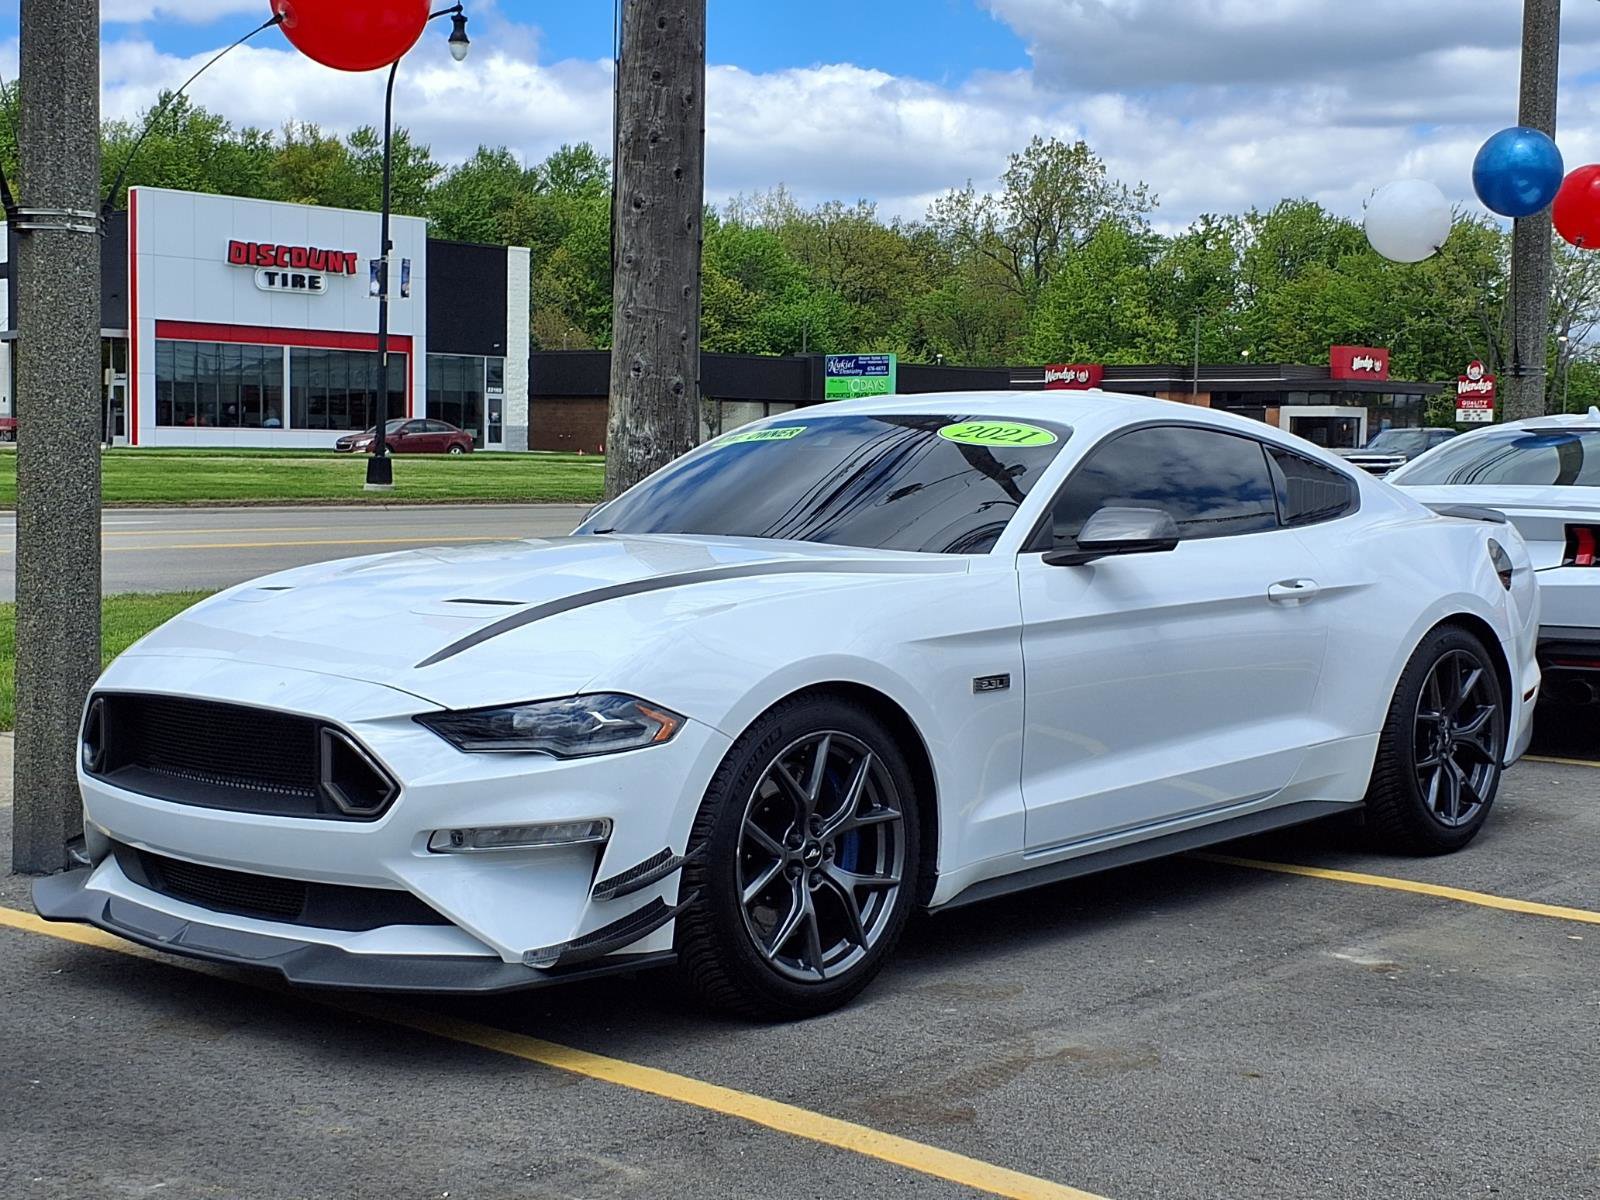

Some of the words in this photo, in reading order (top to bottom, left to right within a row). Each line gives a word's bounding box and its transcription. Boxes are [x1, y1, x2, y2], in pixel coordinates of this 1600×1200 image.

[227, 240, 358, 275] DISCOUNT
[264, 271, 322, 290] TIRE
[1044, 366, 1076, 384] Wendy's
[1458, 378, 1493, 395] Wendy's
[953, 425, 1040, 443] 2021
